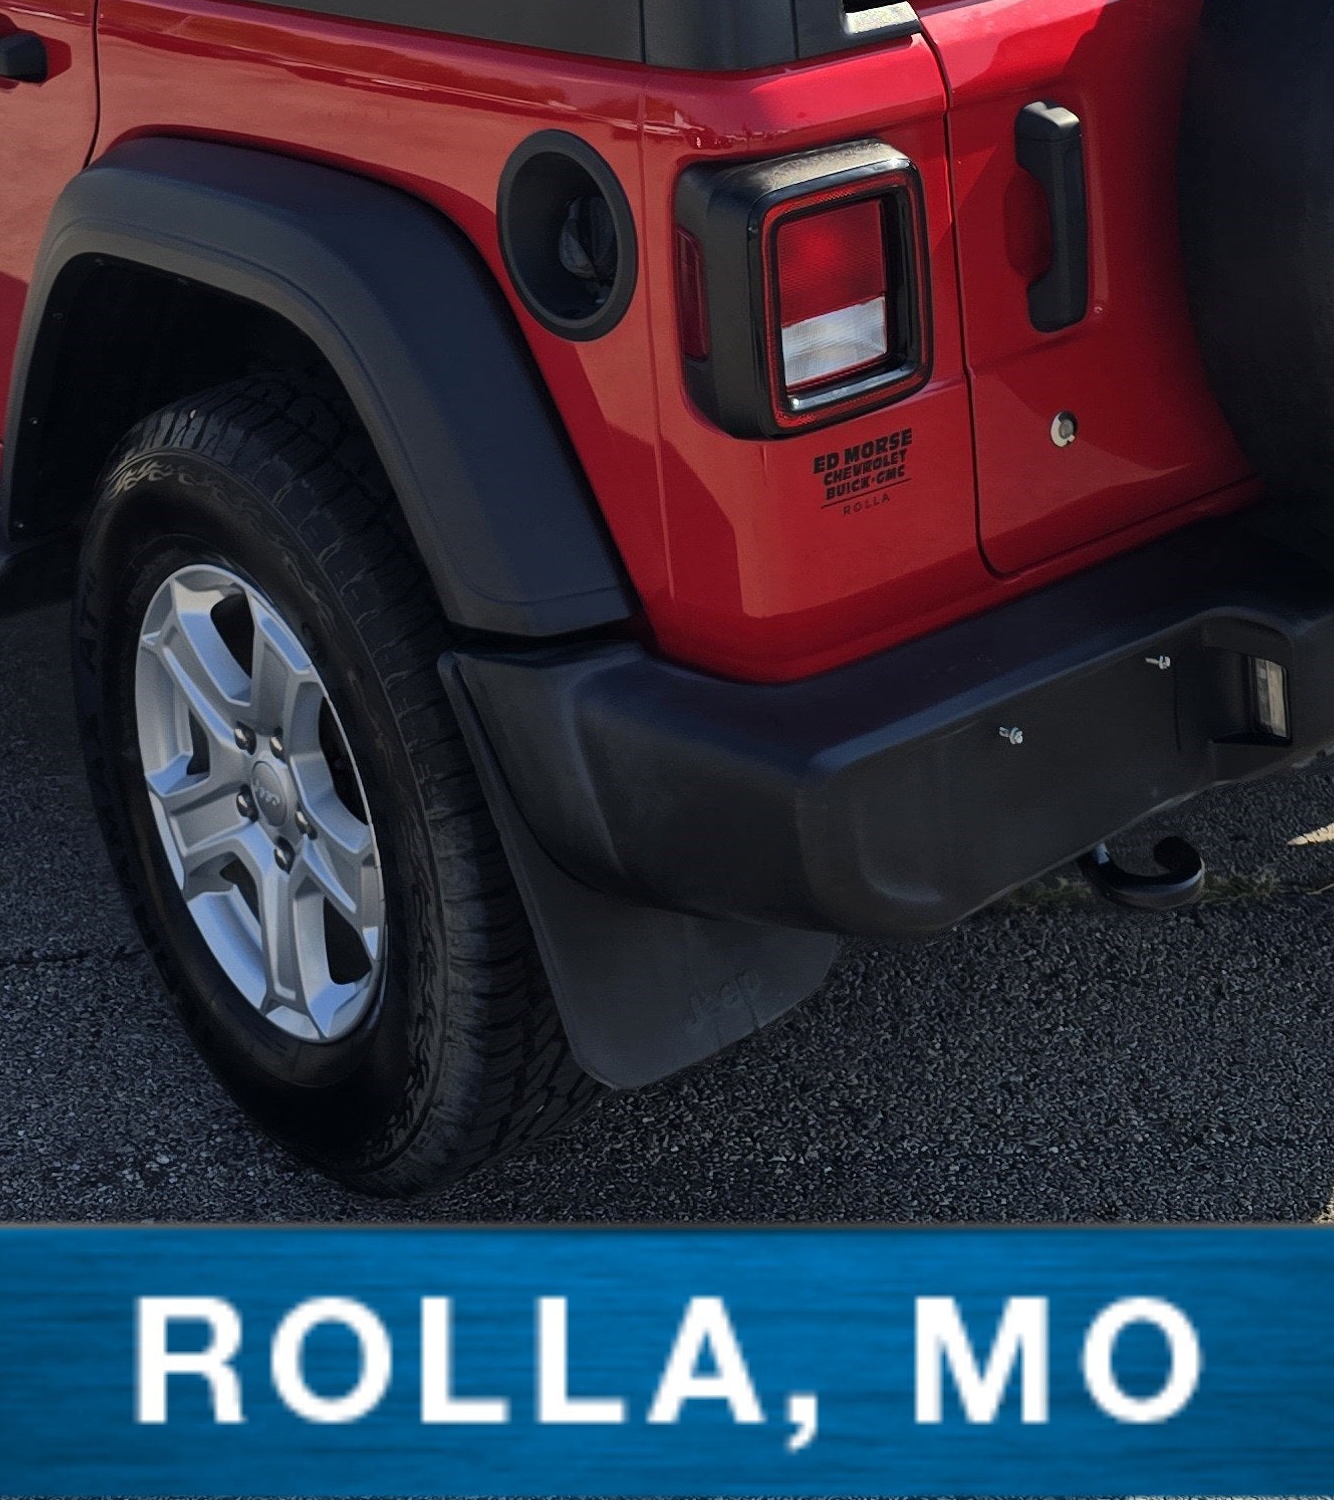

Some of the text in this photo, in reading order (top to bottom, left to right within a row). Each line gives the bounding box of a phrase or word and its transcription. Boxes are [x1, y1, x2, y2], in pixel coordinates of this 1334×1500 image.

[813, 427, 913, 475] ED MORSE
[823, 448, 908, 487] CHEVROLET
[842, 493, 891, 517] ROLLA
